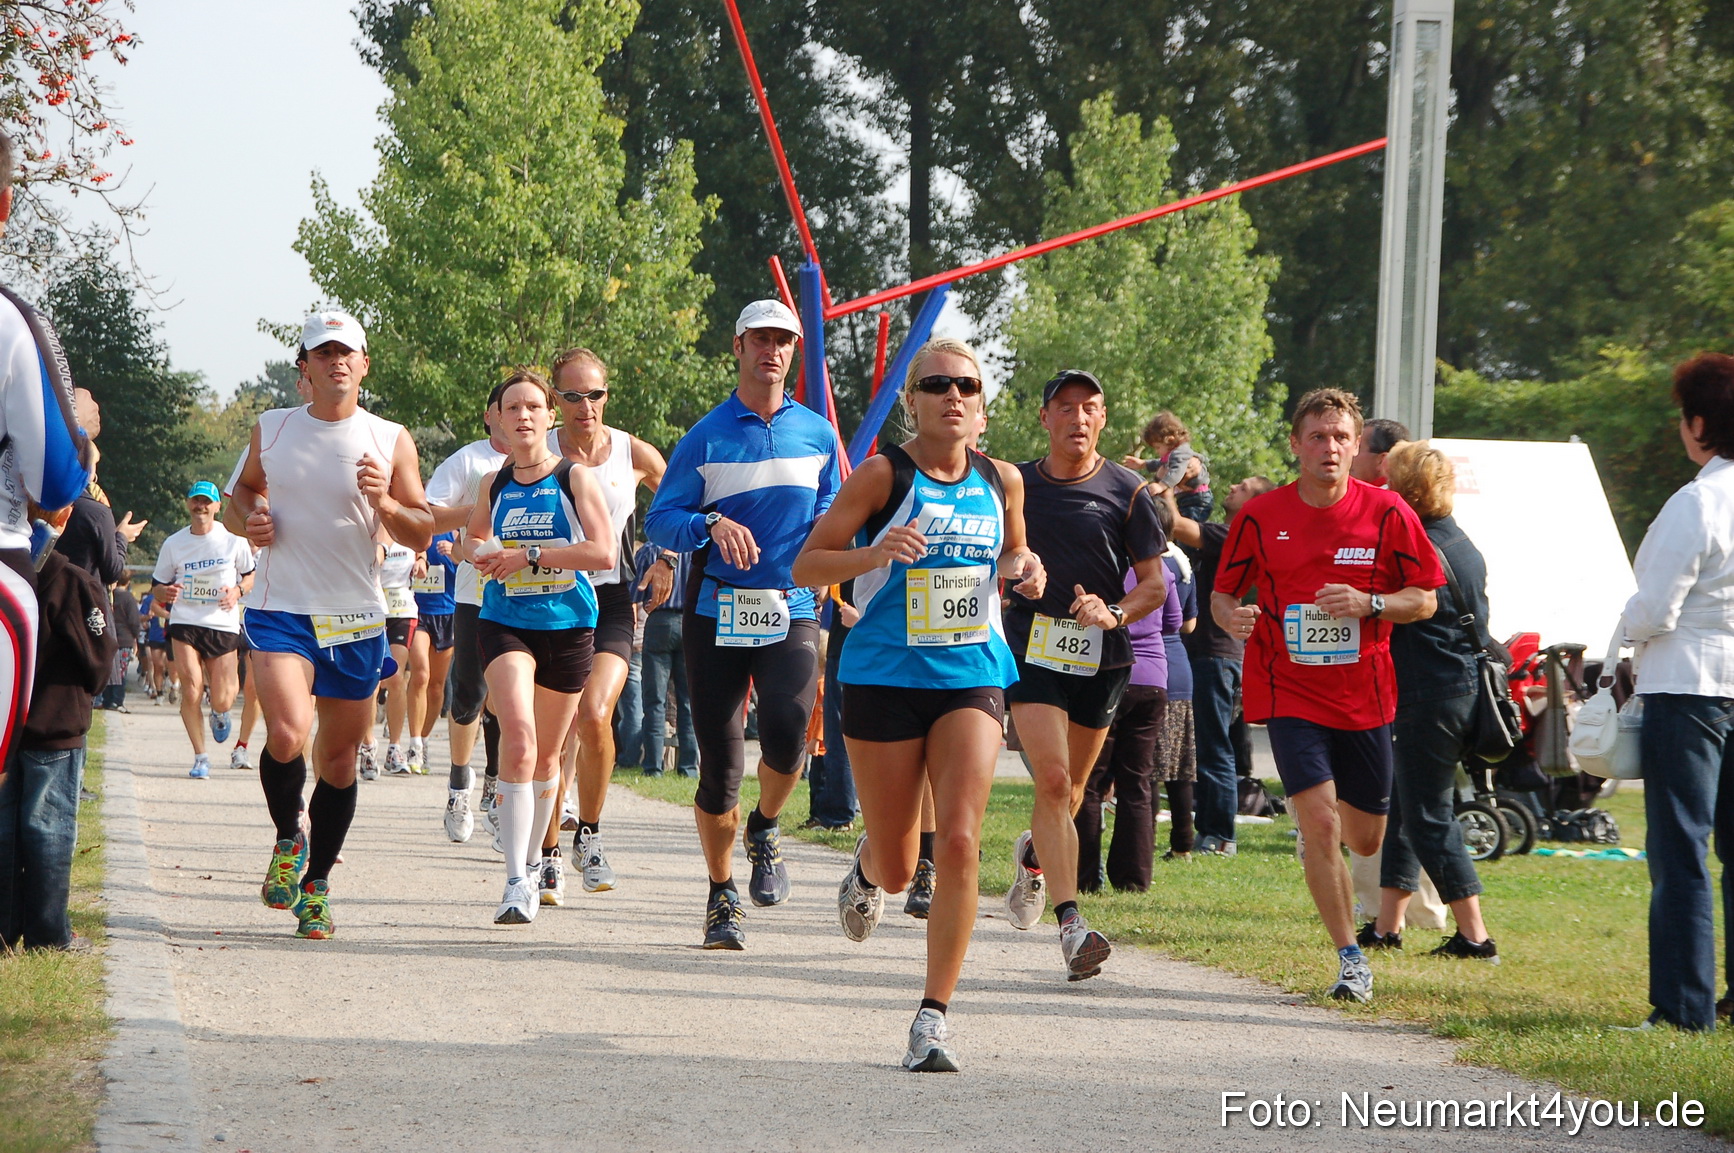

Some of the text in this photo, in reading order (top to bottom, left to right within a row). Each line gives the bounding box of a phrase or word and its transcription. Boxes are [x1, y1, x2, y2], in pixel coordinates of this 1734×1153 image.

[520, 529, 532, 537] 08
[533, 529, 554, 537] Roth
[926, 518, 997, 538] NAGEL
[943, 544, 962, 558] 08
[1334, 547, 1375, 559] JURA
[184, 558, 215, 571] PETER
[933, 574, 981, 590] Christina
[193, 586, 218, 597] 2040
[737, 594, 762, 606] Klaus
[912, 598, 918, 609] B
[722, 609, 727, 618] A
[943, 596, 979, 619] 968
[739, 611, 781, 627] 3042
[1033, 629, 1040, 639] B
[1307, 627, 1351, 643] 2239
[1055, 635, 1091, 656] 482
